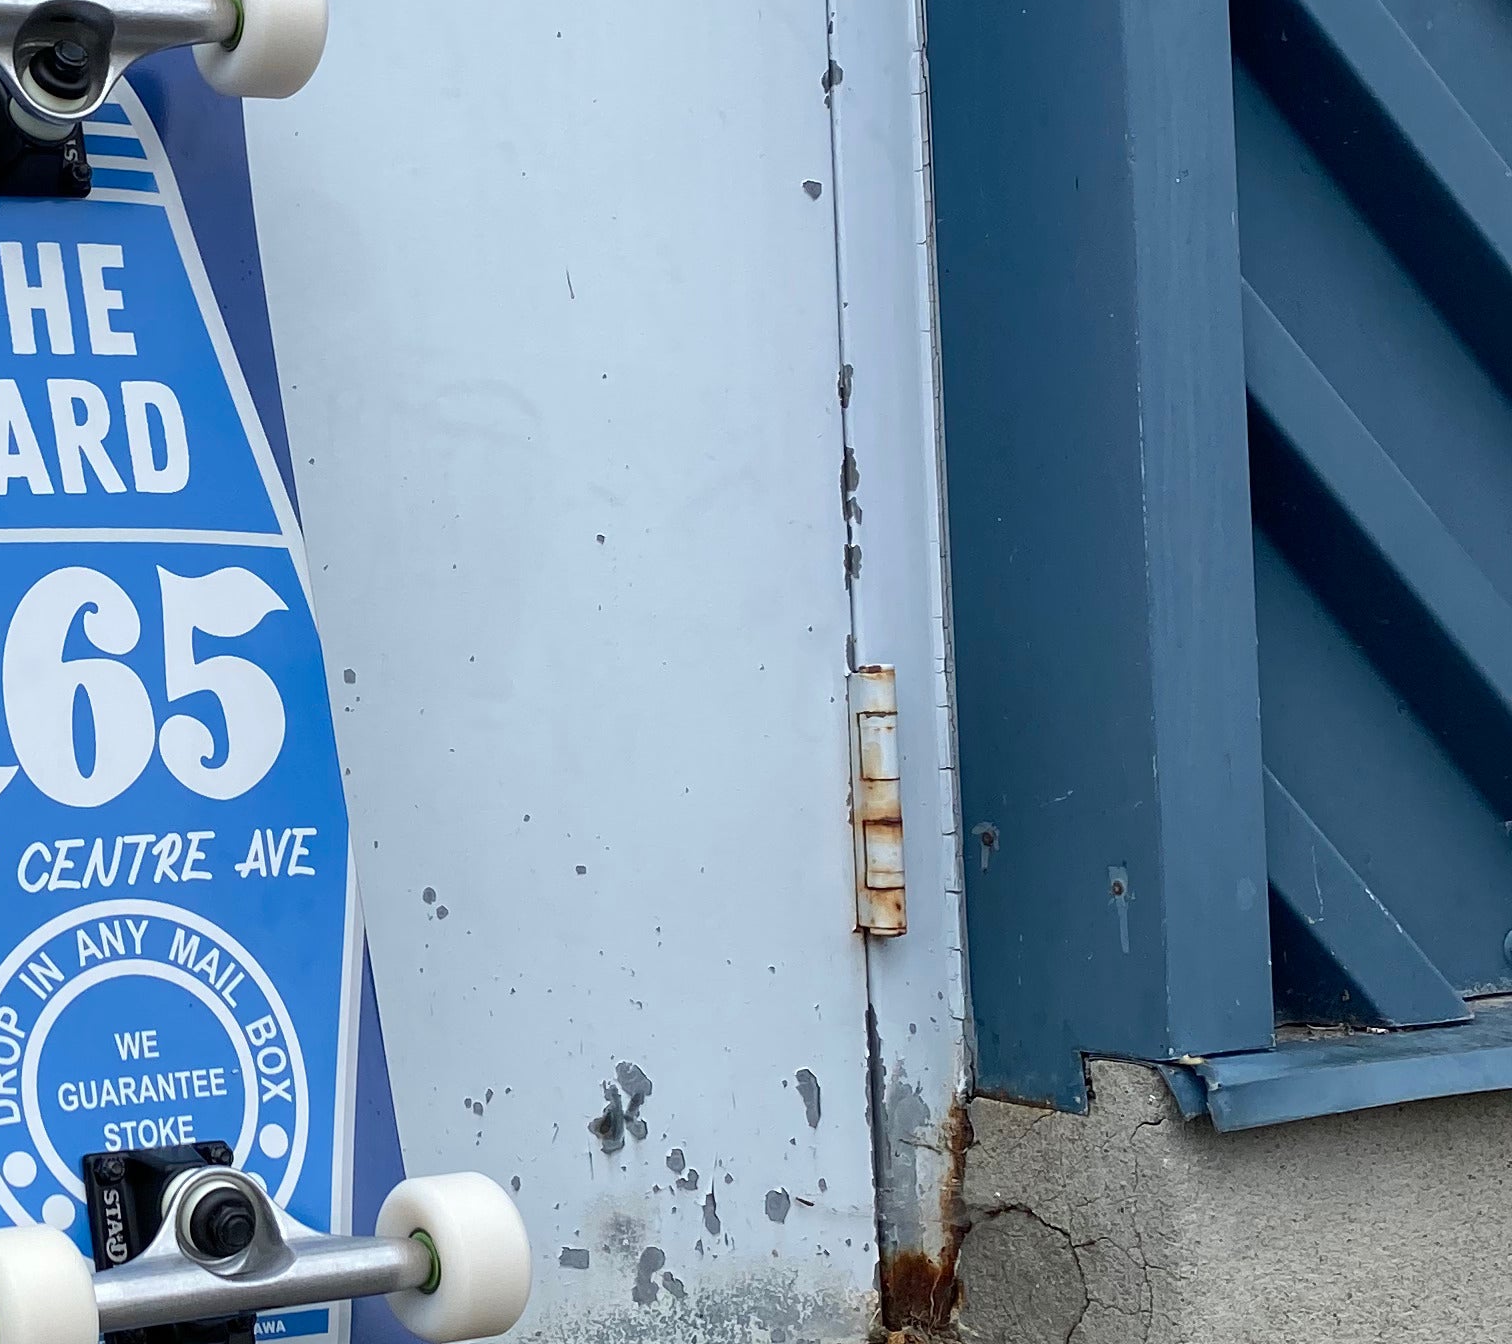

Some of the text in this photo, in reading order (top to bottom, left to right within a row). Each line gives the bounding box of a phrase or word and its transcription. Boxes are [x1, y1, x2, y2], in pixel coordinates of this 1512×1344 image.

[17, 830, 216, 893] CENTRE
[234, 827, 317, 878] AVE
[18, 951, 65, 1000] IN
[76, 919, 149, 967] ANY
[168, 927, 245, 1009] MAIL
[245, 1014, 292, 1103] BOX
[114, 1030, 160, 1061] WE
[58, 1067, 227, 1112] GUARANTEE
[103, 1115, 196, 1152] STOKE
[103, 1188, 128, 1264] STAD
[255, 1319, 286, 1335] AWA
